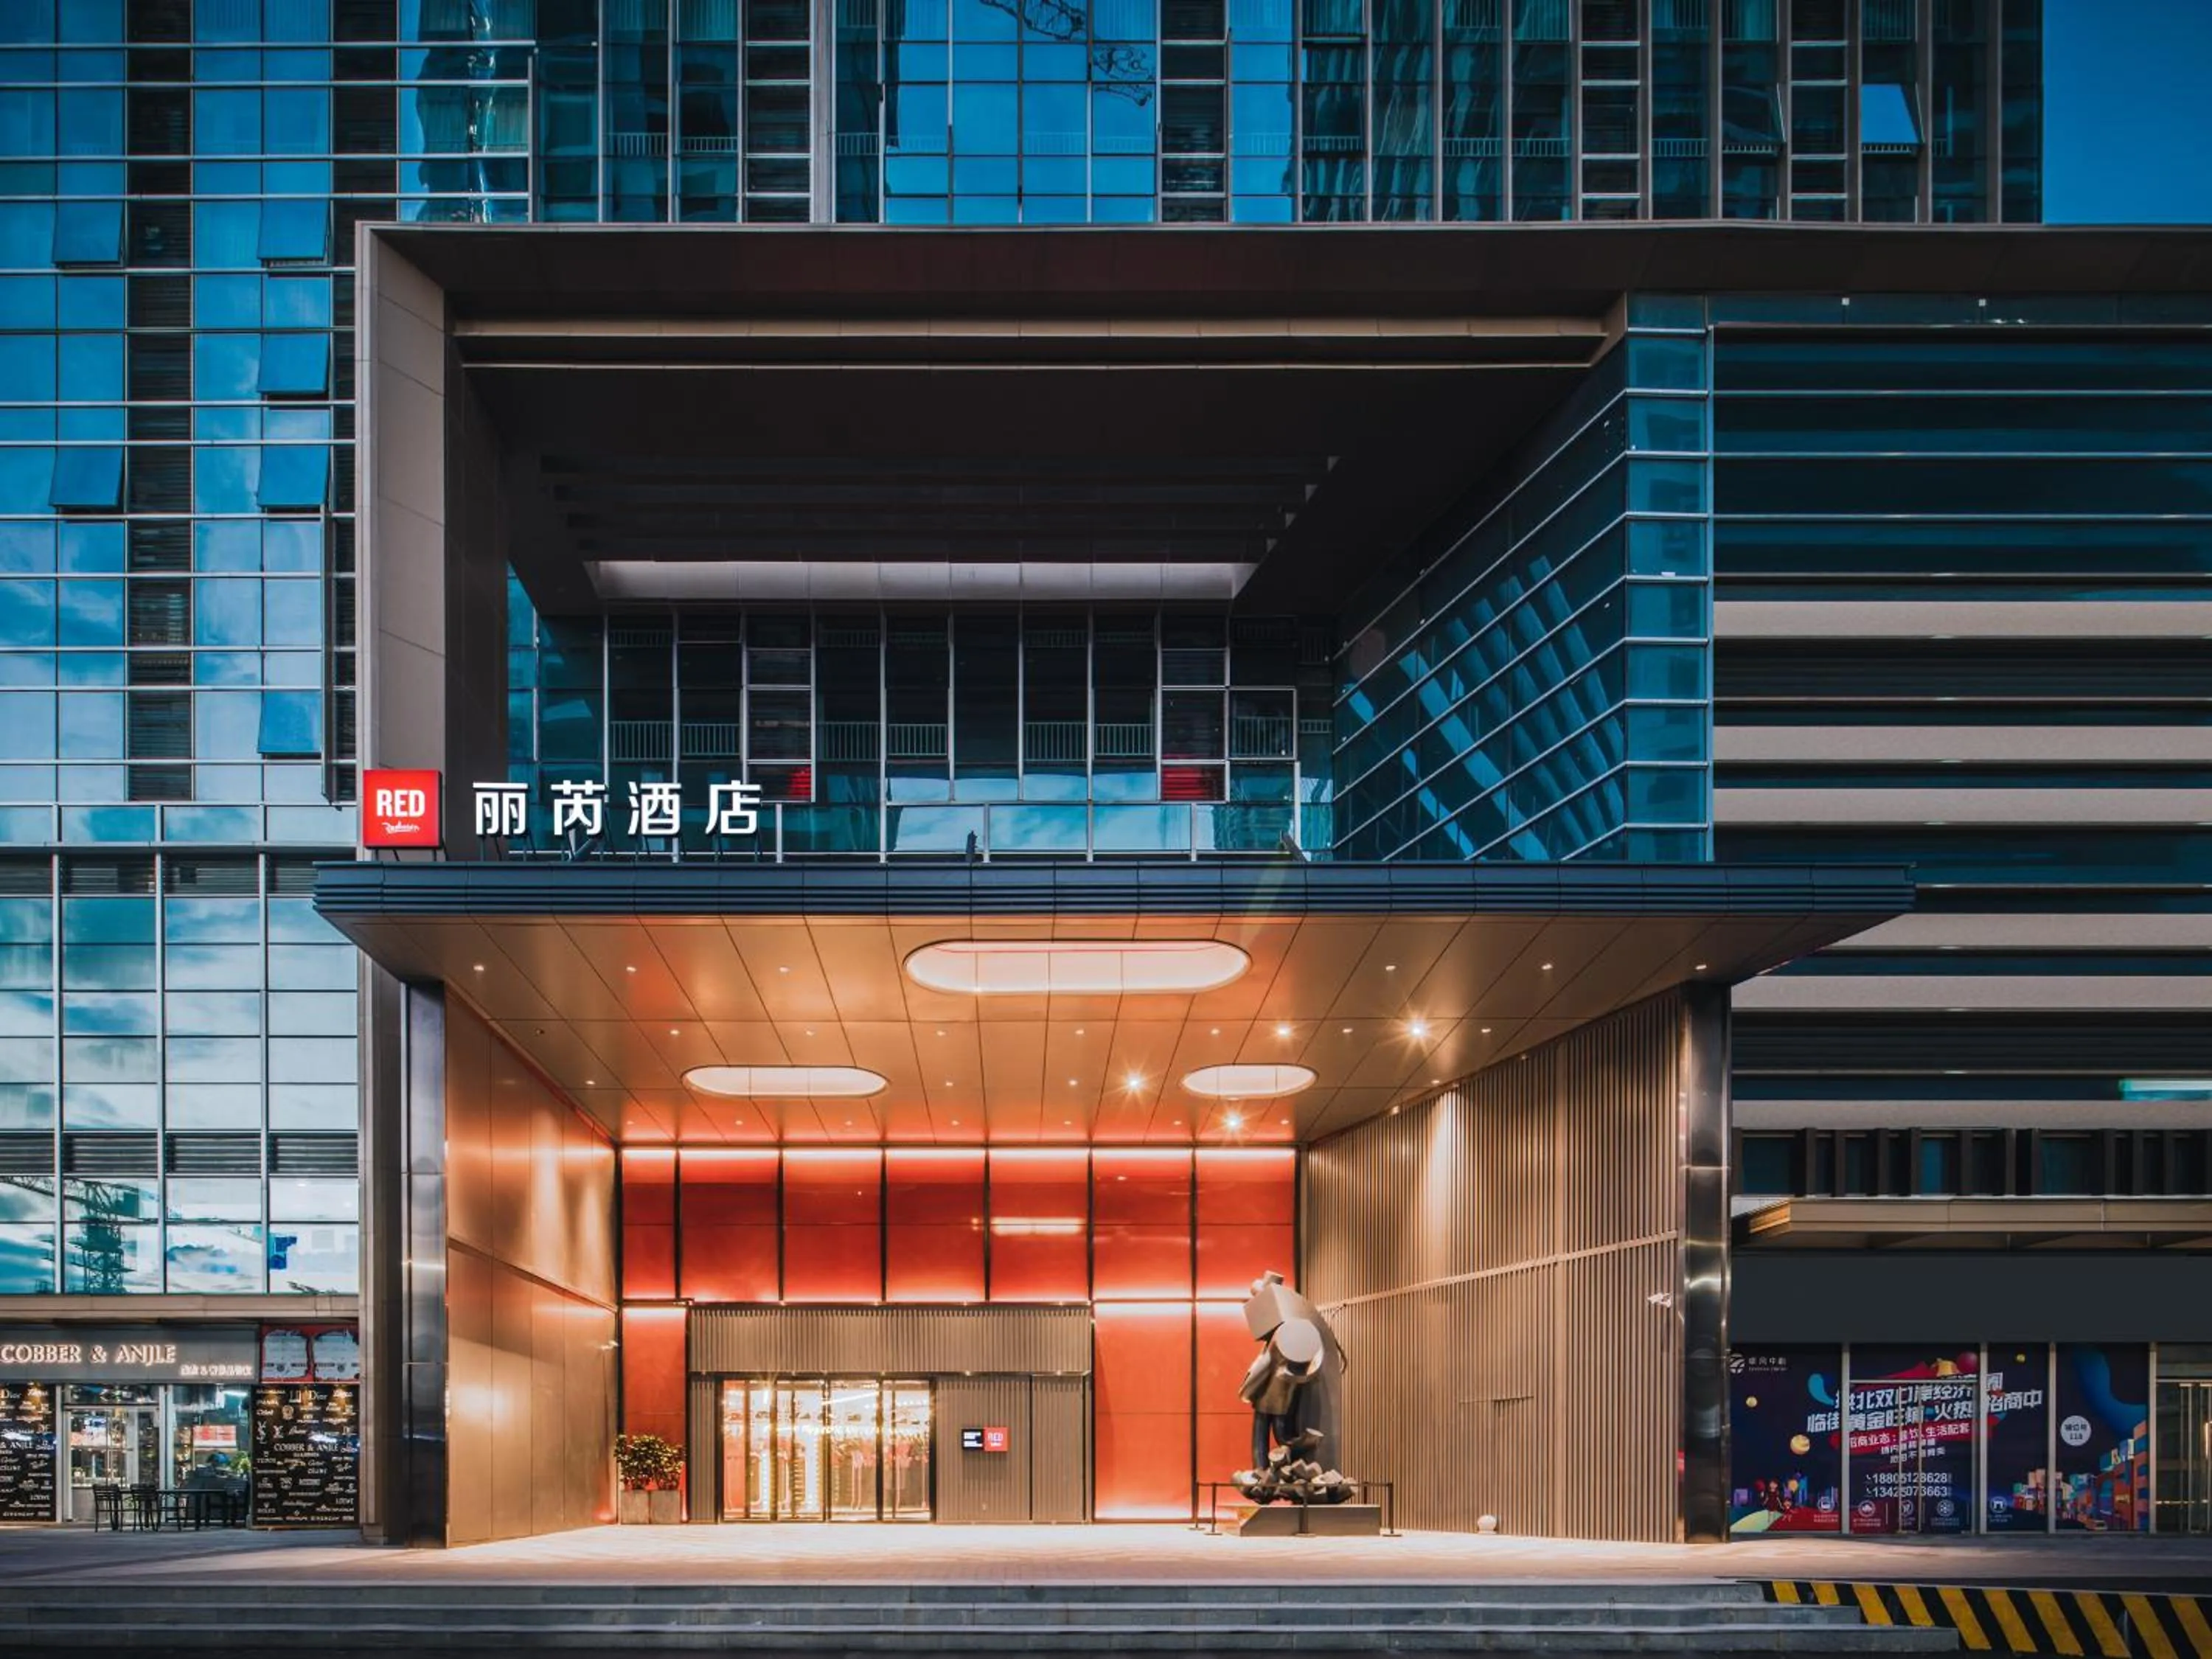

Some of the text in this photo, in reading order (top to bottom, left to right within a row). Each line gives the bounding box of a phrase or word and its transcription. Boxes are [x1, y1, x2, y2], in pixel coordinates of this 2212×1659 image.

[377, 789, 425, 817] RED
[473, 780, 762, 835] 丽芮酒店
[1, 1344, 176, 1366] COBBER & ANJLE
